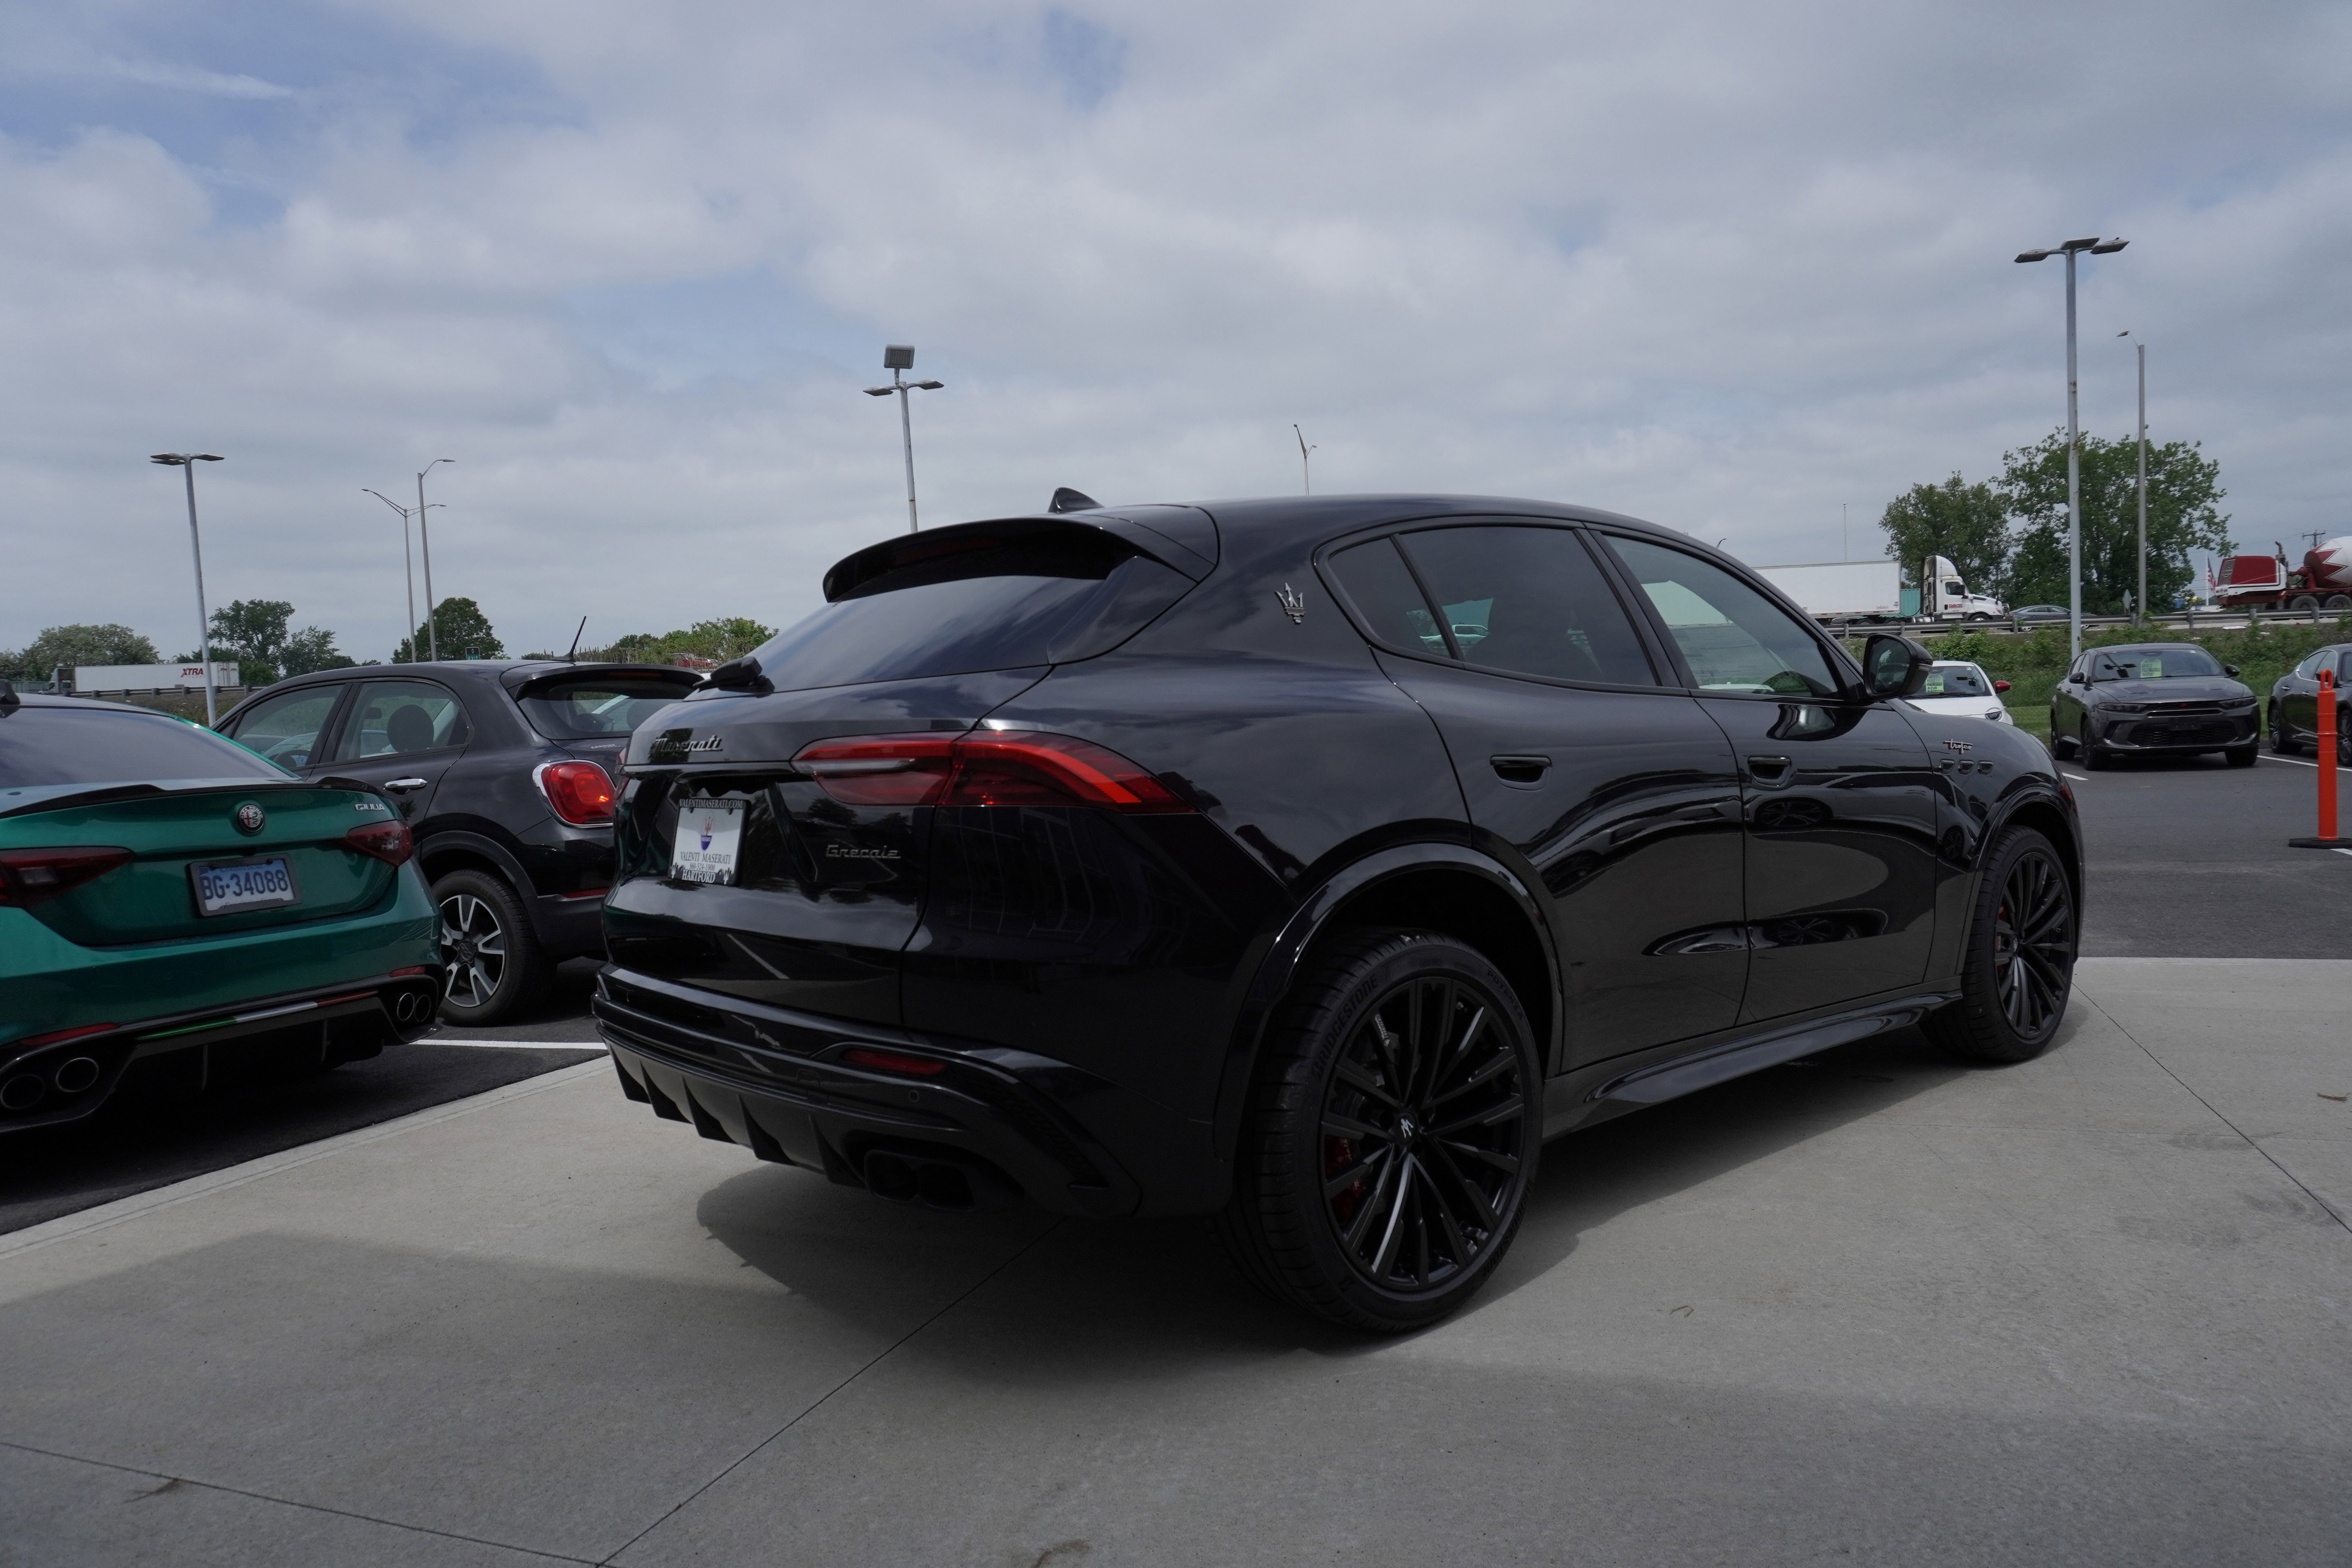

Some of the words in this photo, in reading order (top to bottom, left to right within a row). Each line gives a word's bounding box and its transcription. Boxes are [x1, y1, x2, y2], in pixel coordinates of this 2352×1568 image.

[180, 668, 204, 678] XTRA
[654, 735, 723, 752] Maserati
[679, 799, 743, 808] VALENTIMASERATI.COM
[681, 851, 700, 862] VALENTI
[702, 853, 731, 864] MASERATI
[826, 844, 901, 859] Grecale
[690, 862, 715, 871] 860-524-1000
[682, 870, 715, 883] HARTFORD
